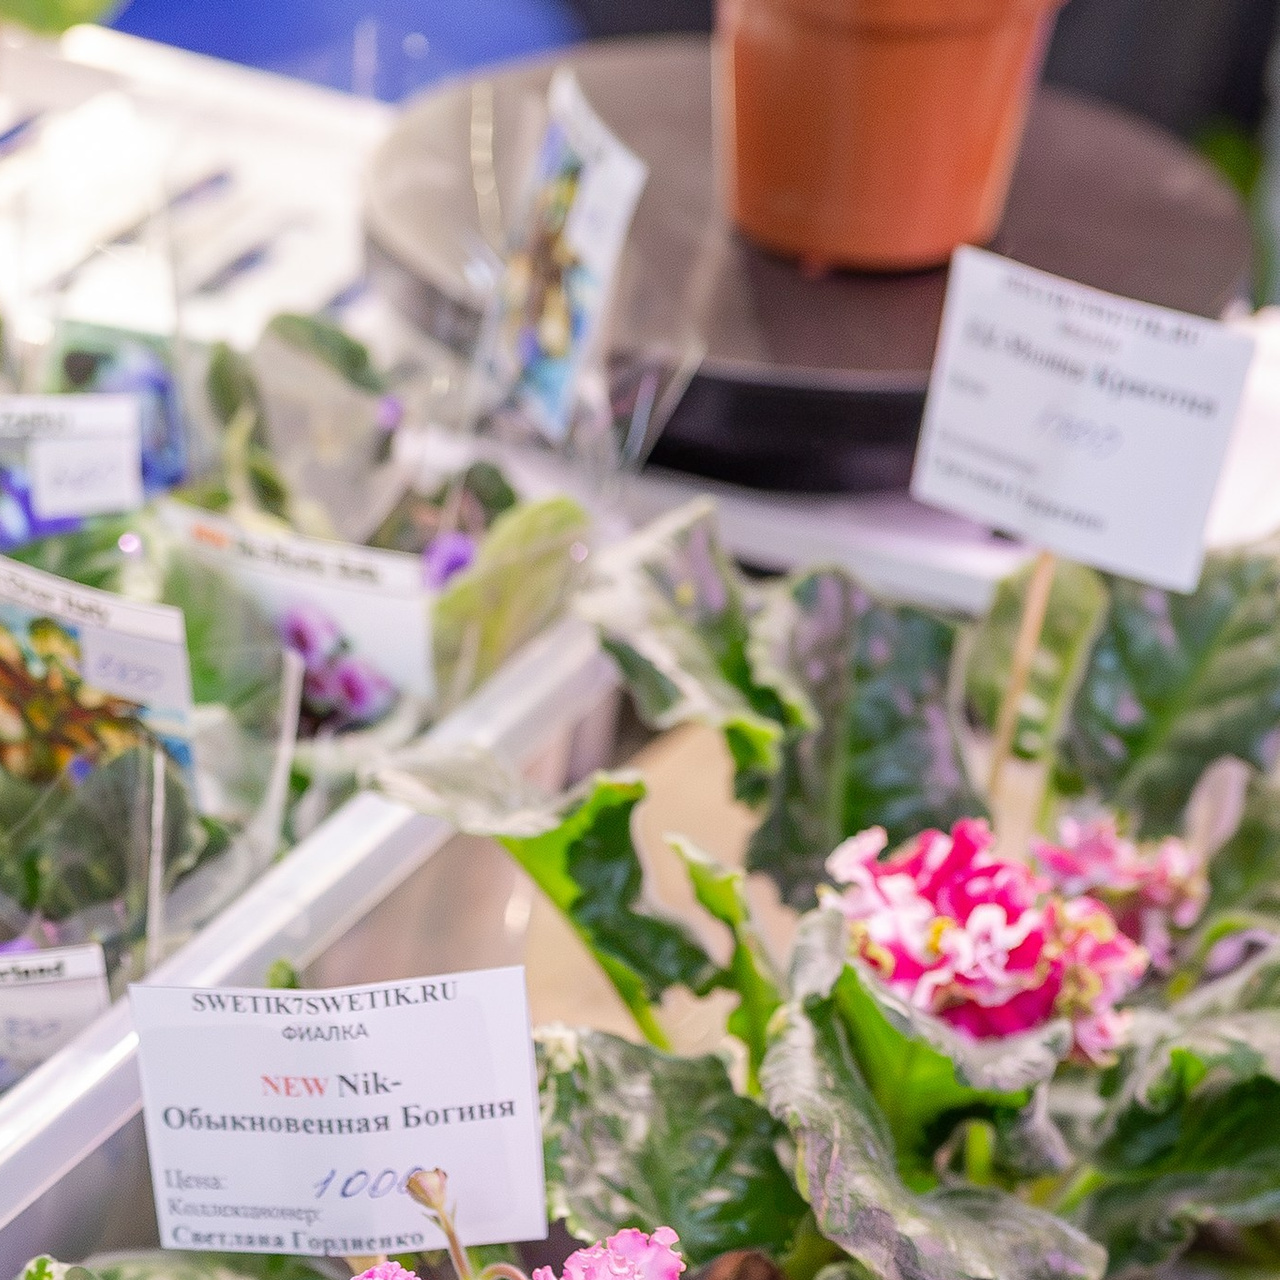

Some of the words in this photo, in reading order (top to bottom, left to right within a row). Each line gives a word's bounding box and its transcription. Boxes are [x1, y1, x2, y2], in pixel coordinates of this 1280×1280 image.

[191, 981, 459, 1015] SWETIK7SWETIK.RU
[281, 1022, 370, 1042] ФИАЛКА
[260, 1074, 329, 1098] NEW
[337, 1071, 403, 1097] Nik-
[162, 1106, 392, 1135] Обыкновенная
[401, 1100, 517, 1130] Богиня
[172, 1225, 285, 1249] Светлана
